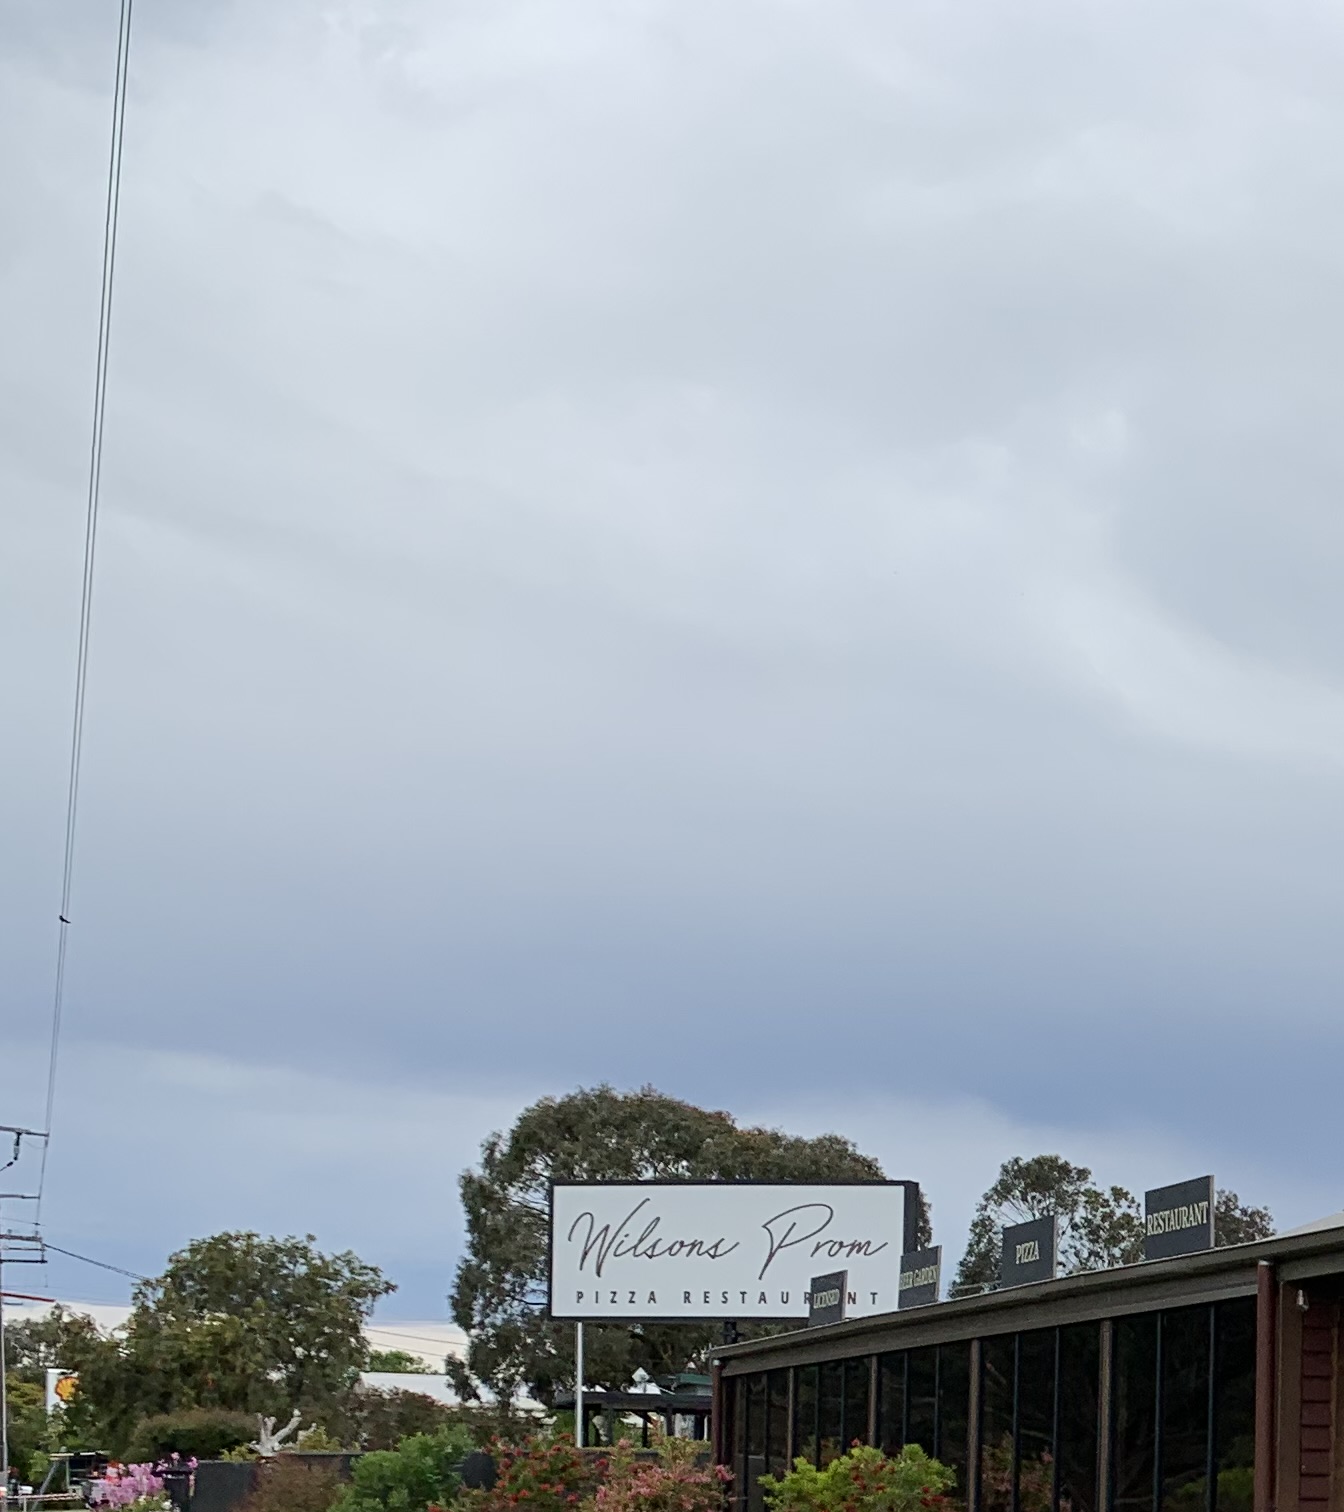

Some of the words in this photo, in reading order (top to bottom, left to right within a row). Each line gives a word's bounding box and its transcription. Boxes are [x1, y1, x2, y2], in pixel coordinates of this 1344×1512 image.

[1146, 1201, 1209, 1236] RESTAURANT
[567, 1197, 740, 1279] Wilsons
[757, 1203, 889, 1281] Prom
[1015, 1240, 1040, 1265] PIZZA
[576, 1290, 657, 1305] PIZZA
[683, 1290, 880, 1305] RESTAURNT
